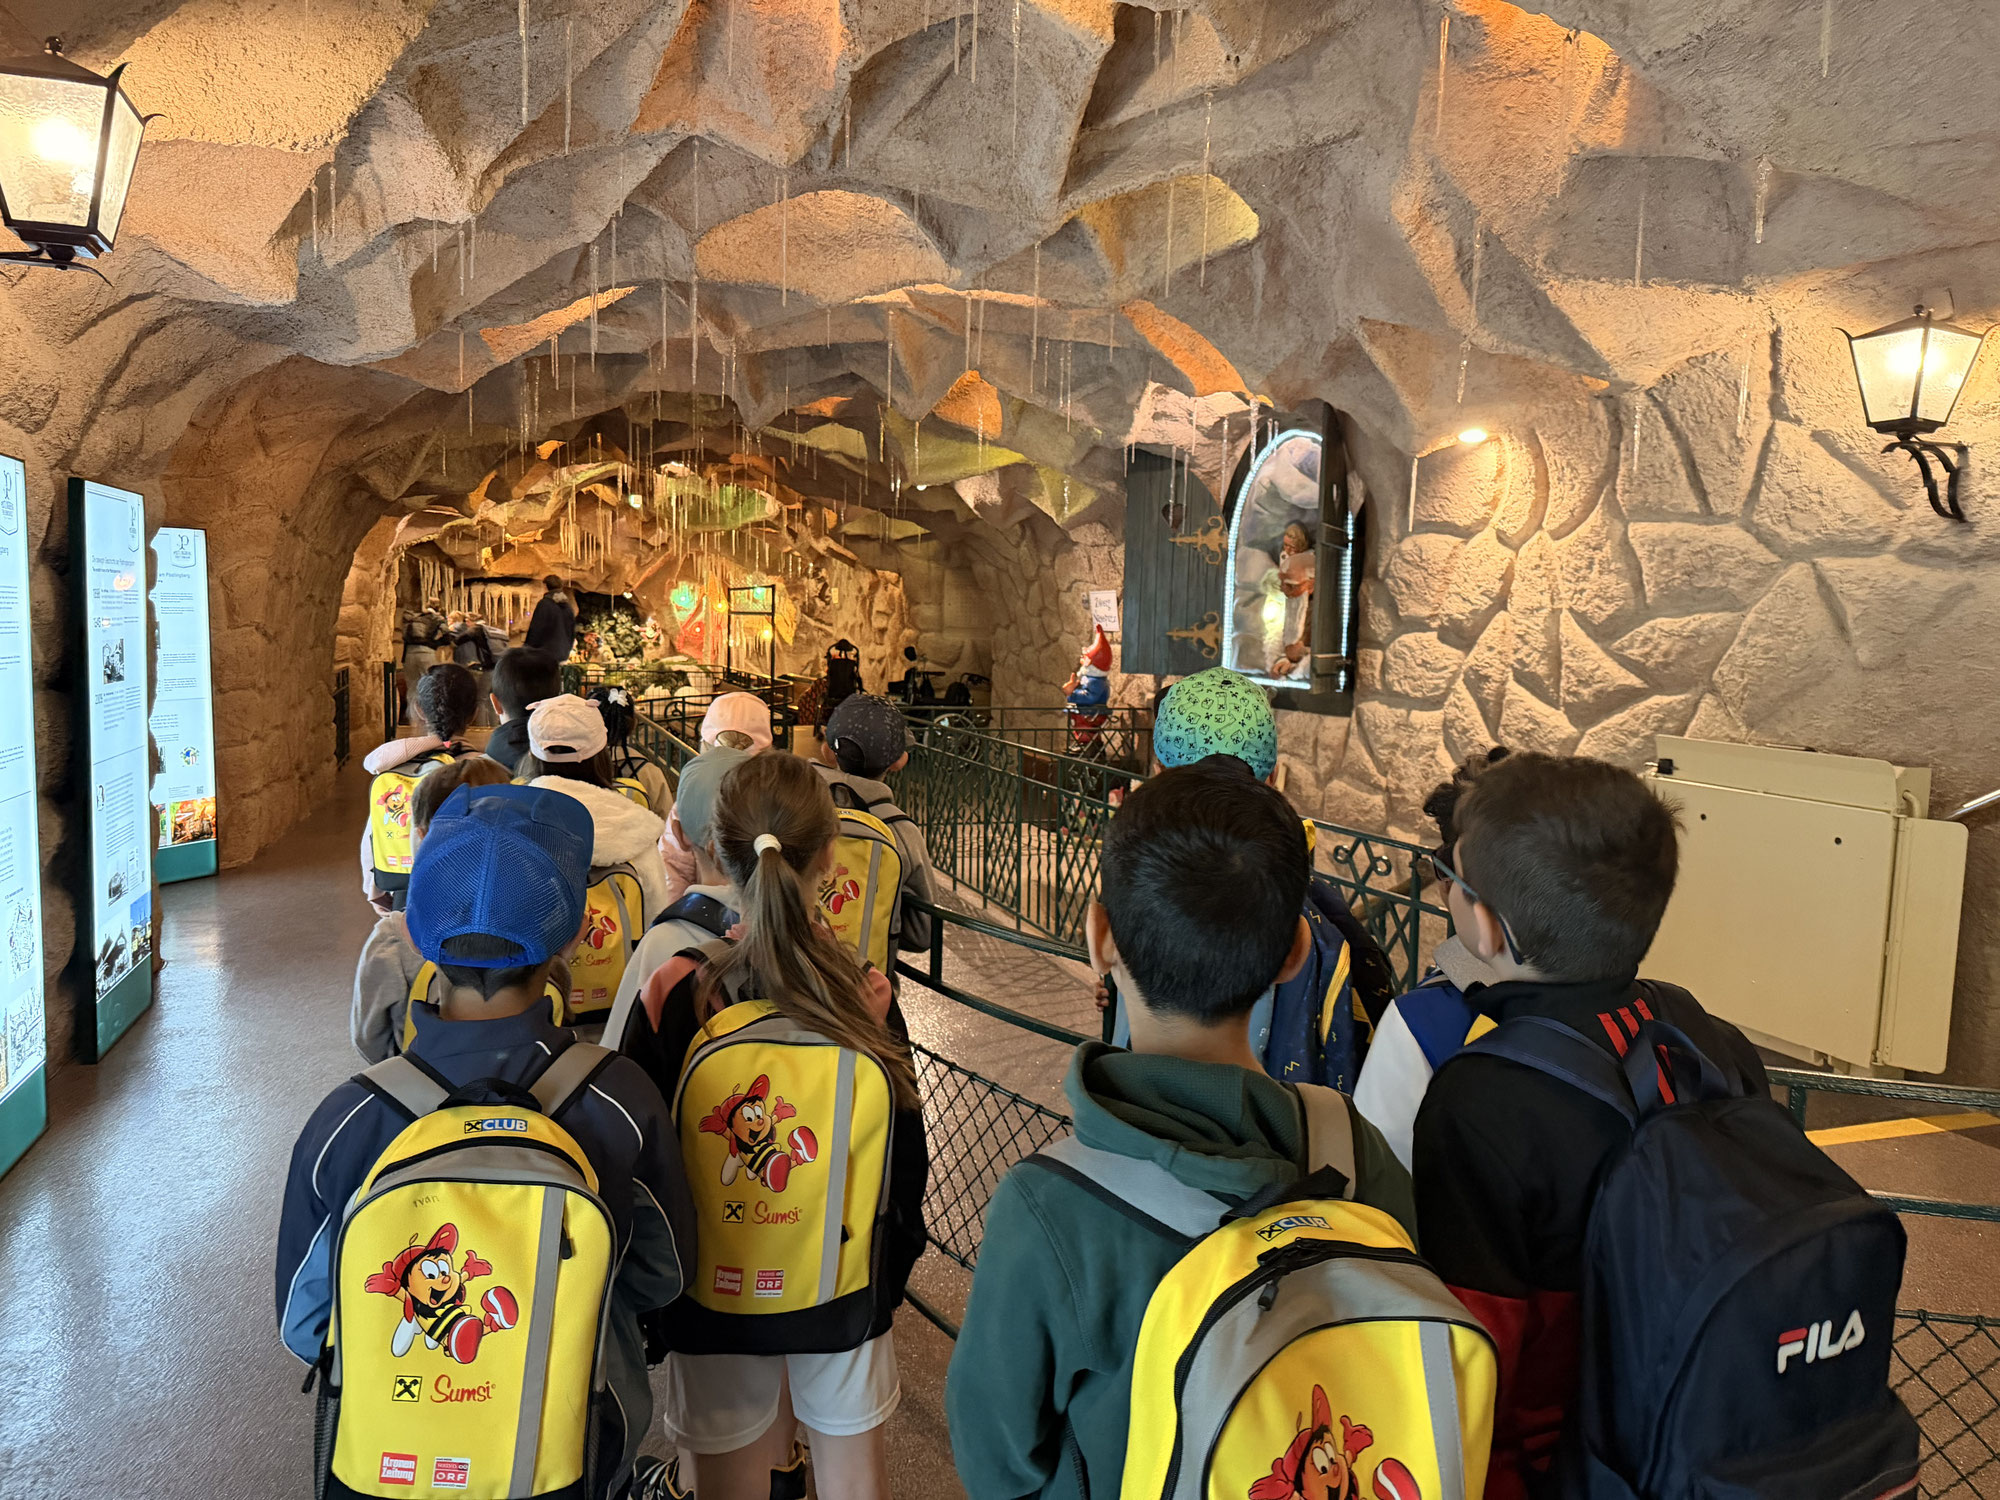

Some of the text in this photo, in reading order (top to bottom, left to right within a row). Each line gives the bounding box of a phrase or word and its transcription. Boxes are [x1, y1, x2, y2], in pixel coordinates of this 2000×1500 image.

[482, 1119, 527, 1131] CLUB
[751, 1200, 799, 1225] Sumsi
[1278, 1216, 1332, 1231] CLUB
[757, 1280, 782, 1289] ORF
[1776, 1309, 1866, 1375] FILA
[430, 1374, 492, 1404] Sumsi
[436, 1472, 466, 1481] ORF
